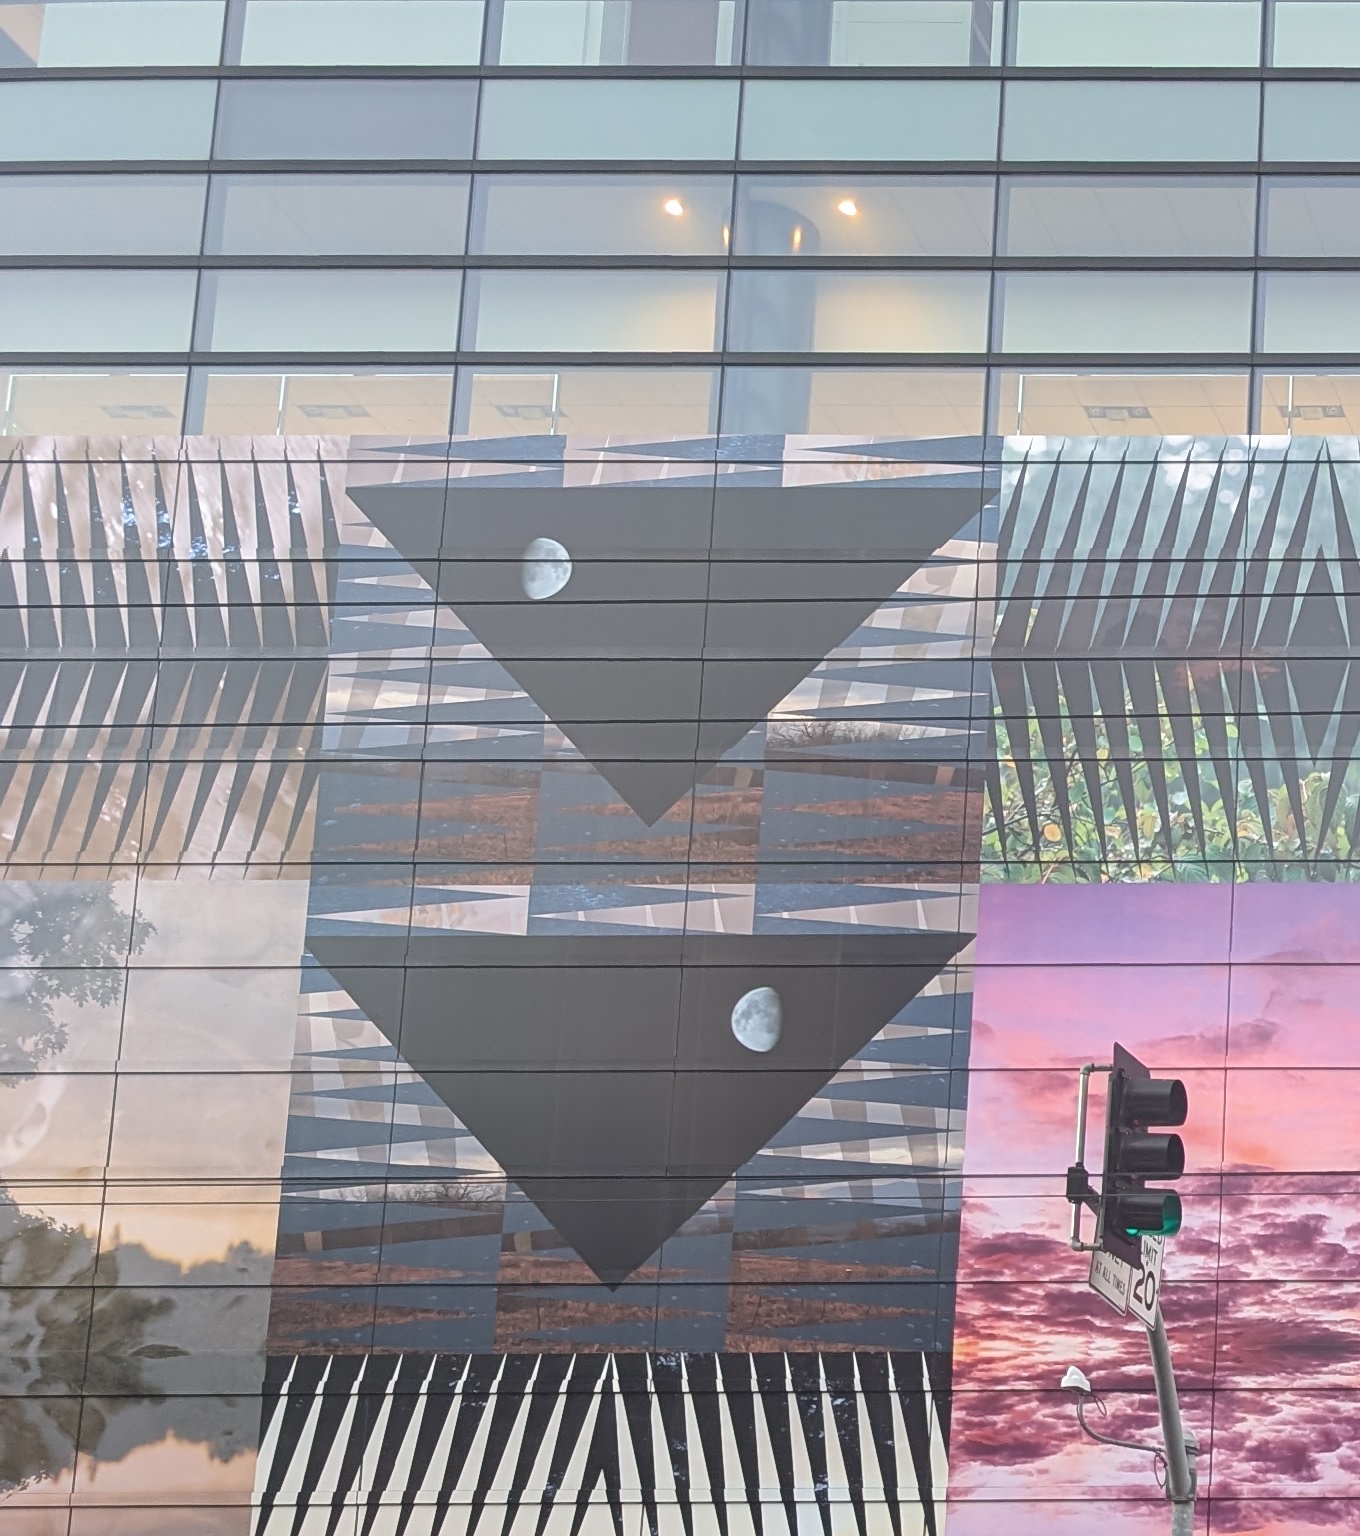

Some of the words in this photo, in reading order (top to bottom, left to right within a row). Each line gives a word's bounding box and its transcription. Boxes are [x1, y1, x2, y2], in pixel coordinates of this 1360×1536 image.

[1095, 1260, 1102, 1275] AT
[1102, 1264, 1111, 1284] ALL
[1113, 1274, 1126, 1296] TIMES
[1133, 1264, 1156, 1311] 20
